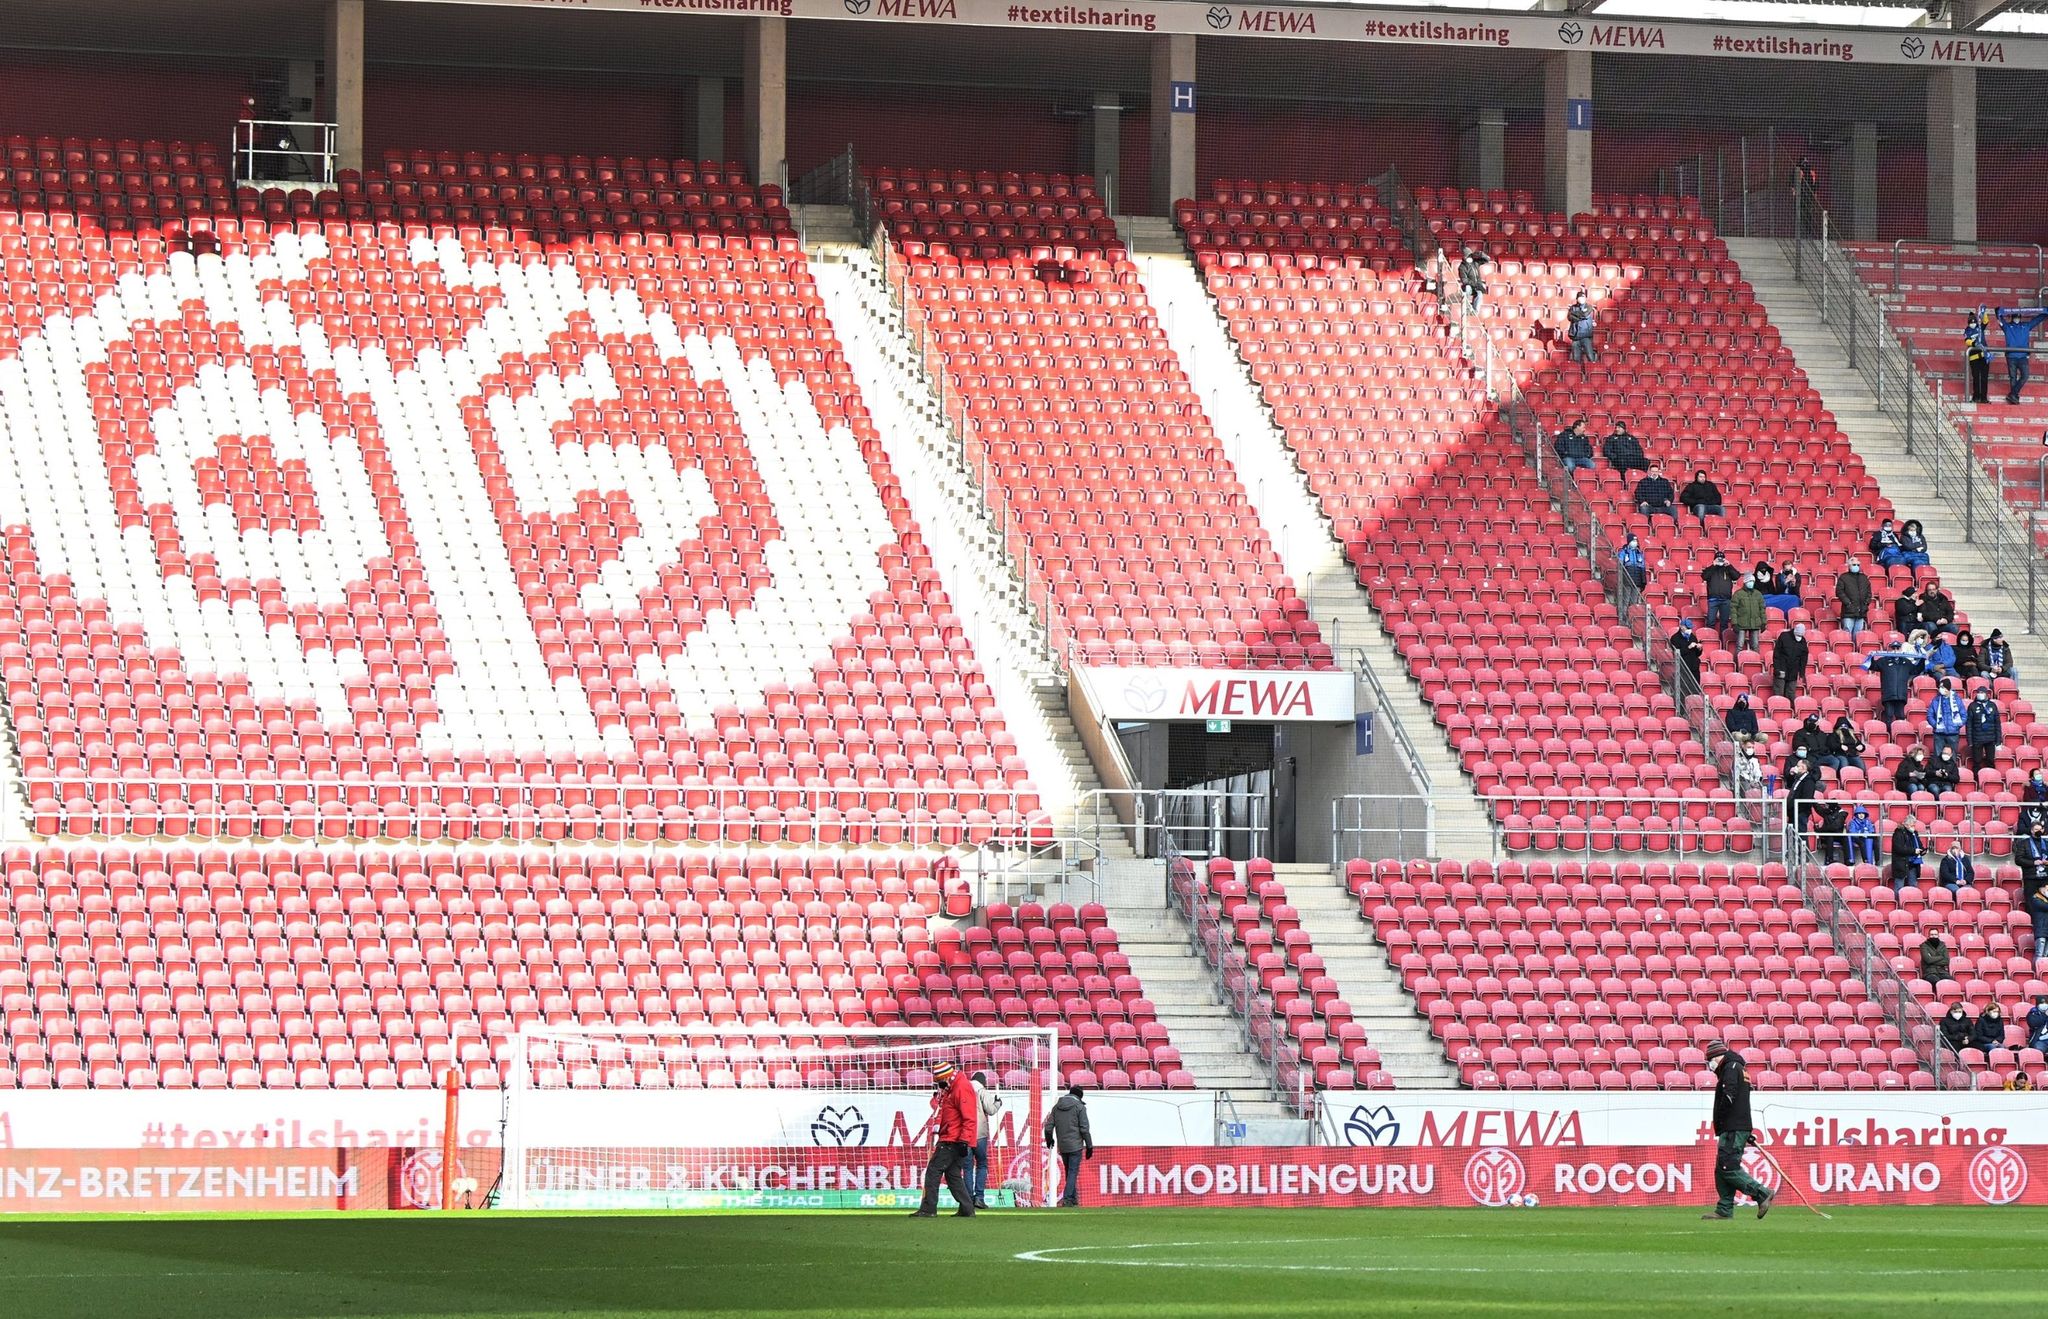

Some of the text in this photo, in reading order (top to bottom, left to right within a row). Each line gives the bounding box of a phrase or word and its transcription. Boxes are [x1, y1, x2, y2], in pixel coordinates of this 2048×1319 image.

[877, 0, 957, 19] MEWA
[1007, 5, 1157, 31] #textilsharing
[1238, 10, 1317, 34] MEWA
[1365, 20, 1510, 46] #textilsharing
[1590, 25, 1666, 49] MEWA
[1713, 34, 1854, 61] #textilsharing
[1931, 40, 2005, 63] MEWA
[1174, 86, 1193, 108] H
[1179, 679, 1314, 717] MEWA
[1364, 719, 1373, 747] H
[1100, 1163, 1434, 1195] IMMOBILIENGURU
[1555, 1162, 1692, 1194] ROCON
[1809, 1161, 1941, 1193] URANO
[859, 1193, 896, 1206] fb88
